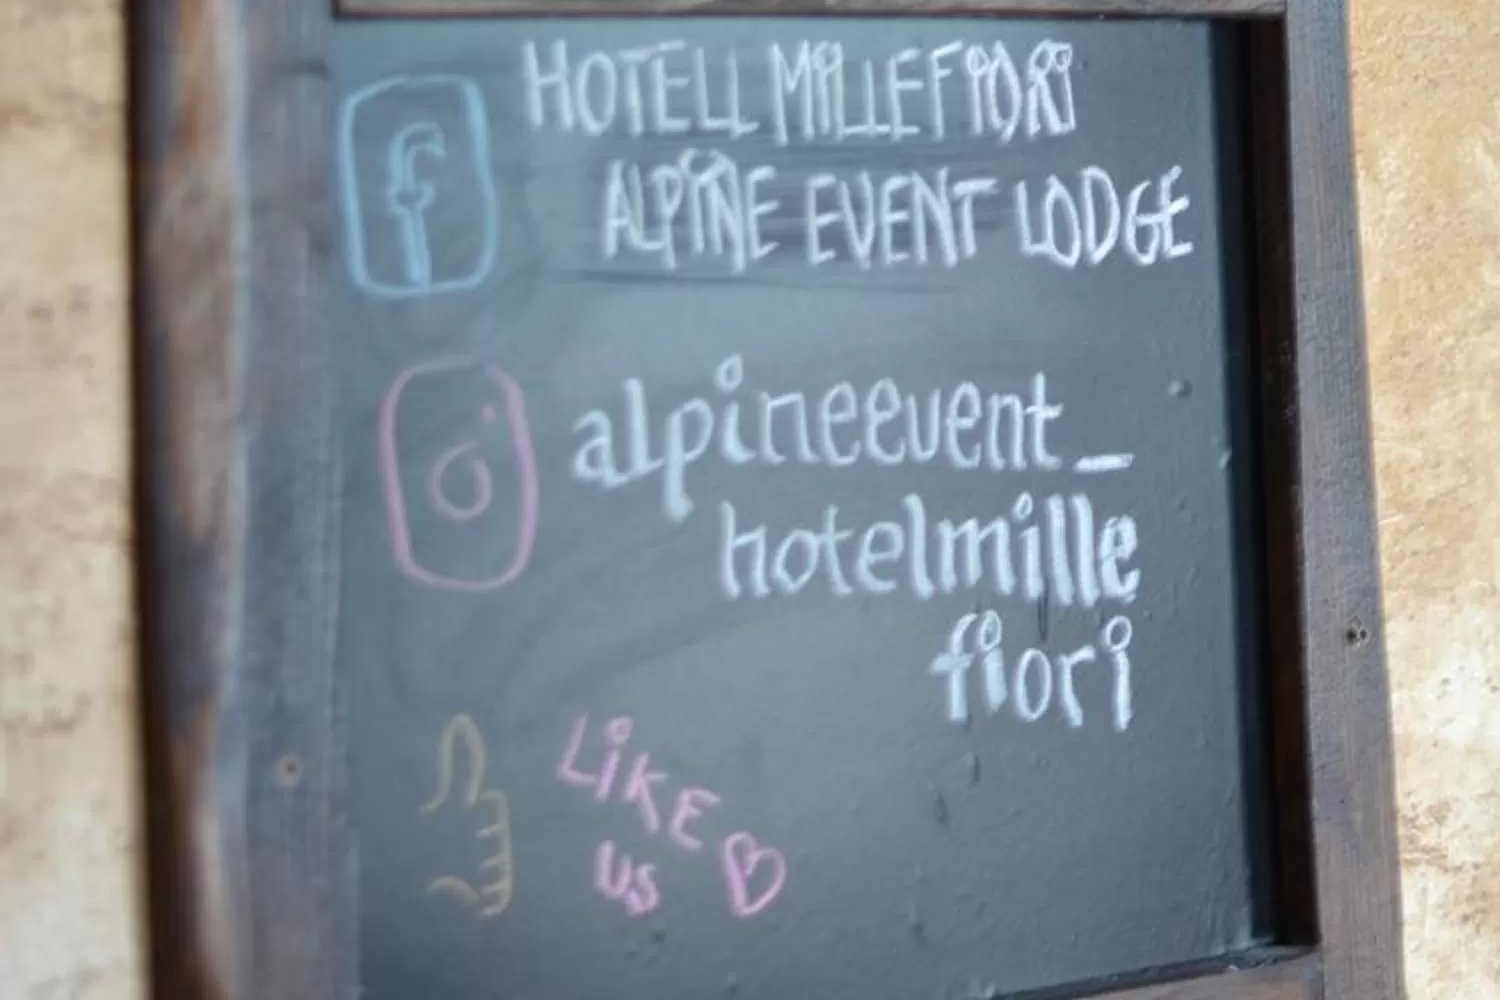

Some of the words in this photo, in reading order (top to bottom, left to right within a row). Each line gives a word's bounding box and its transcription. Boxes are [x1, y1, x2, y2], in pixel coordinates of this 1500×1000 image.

[806, 172, 998, 268] EVENT
[1014, 164, 1194, 270] LODGE
[718, 493, 1141, 606] hotelmille
[930, 608, 1134, 732] fiori
